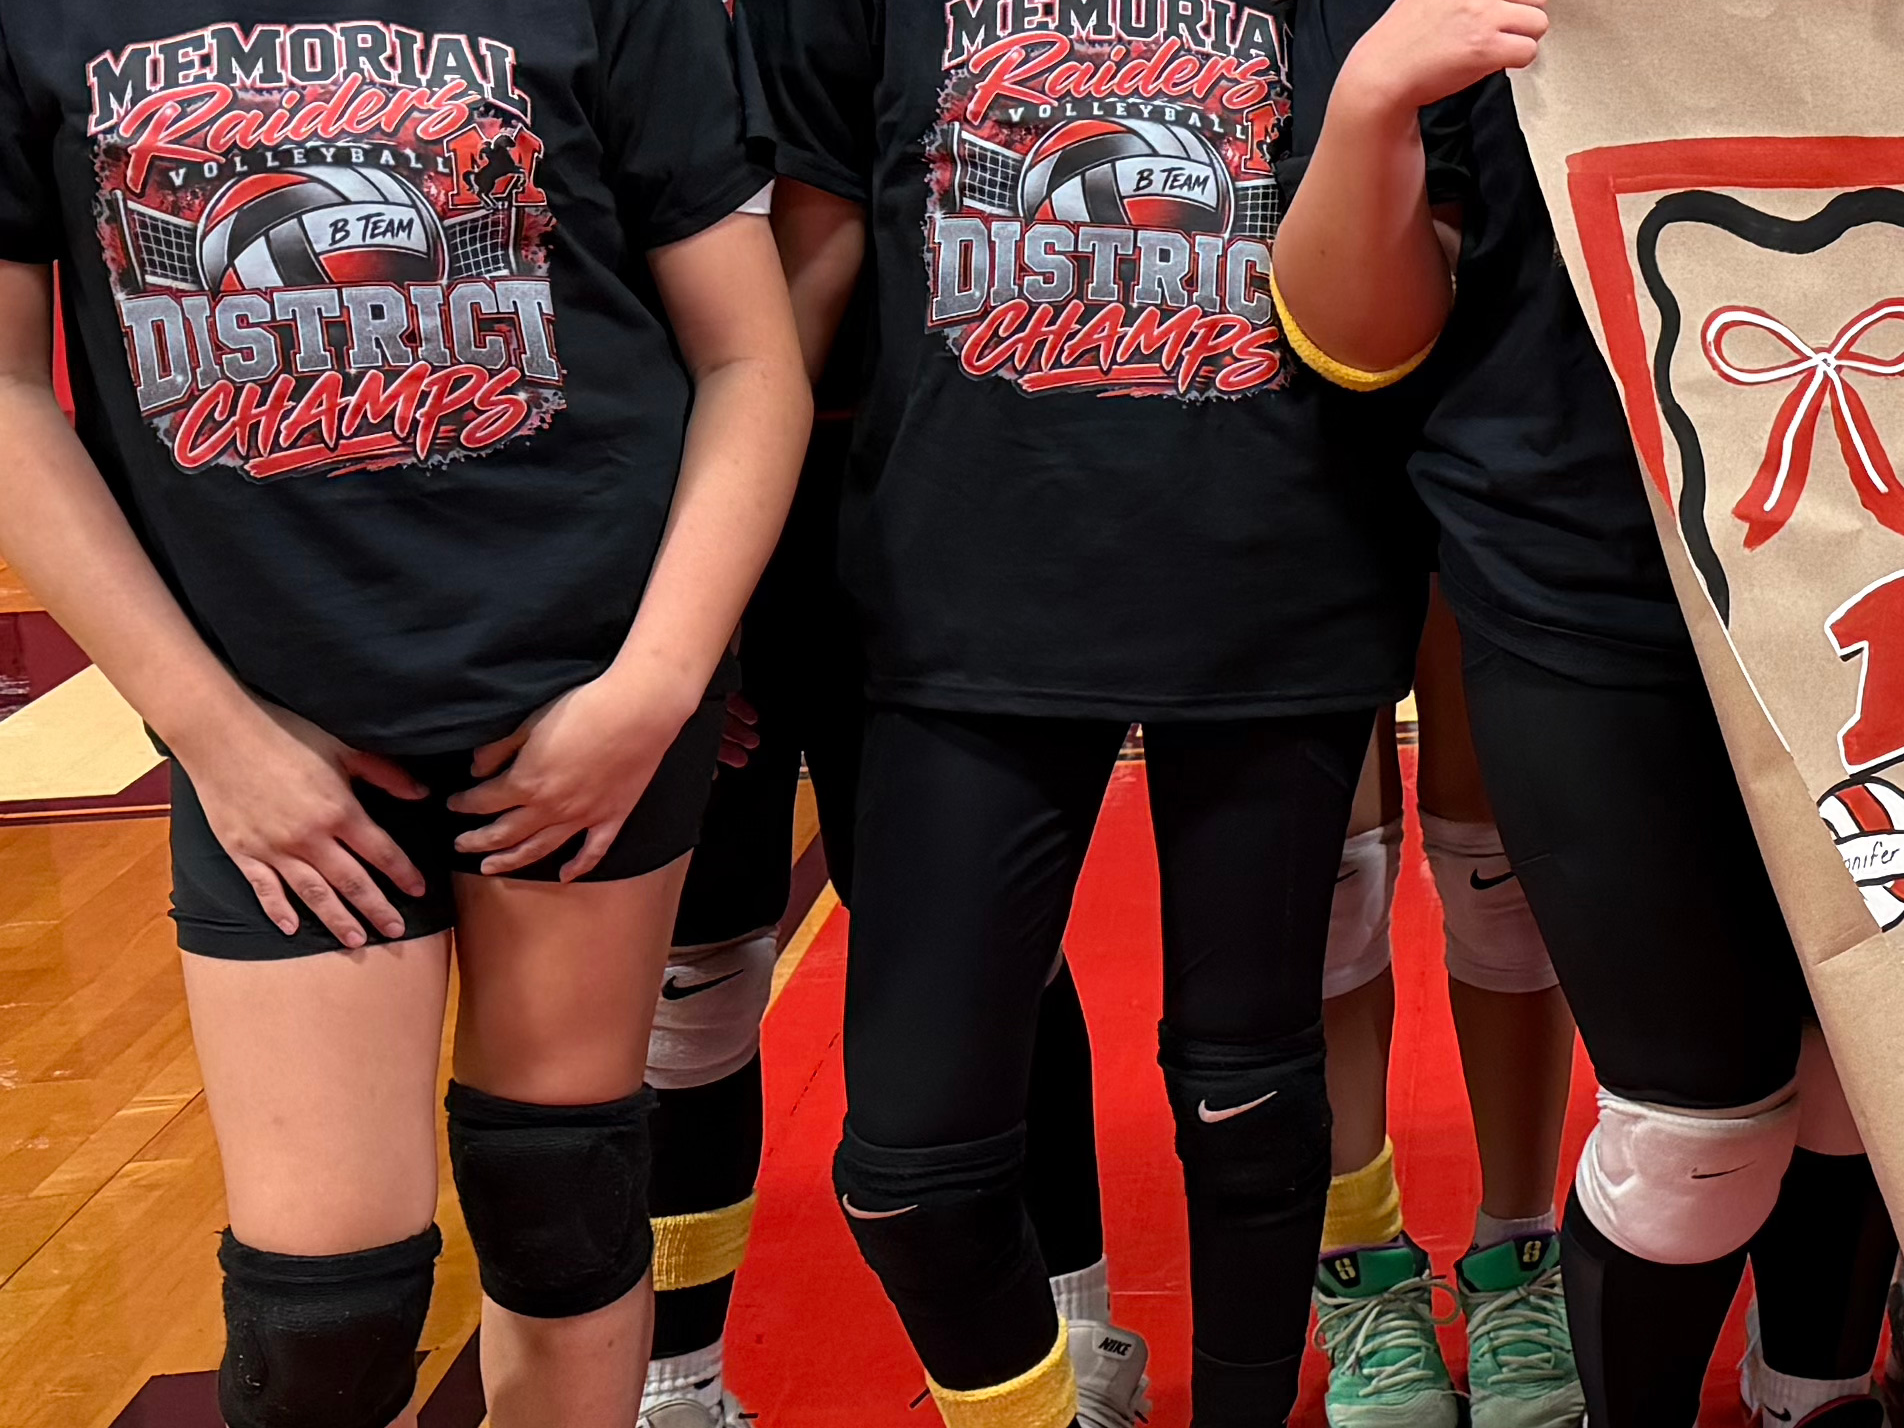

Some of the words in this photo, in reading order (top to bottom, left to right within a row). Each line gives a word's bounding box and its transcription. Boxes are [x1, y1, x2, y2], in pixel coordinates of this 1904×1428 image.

[87, 20, 531, 137] MEMORIAL
[966, 30, 1270, 127] Raiders
[1009, 101, 1247, 139] VOLLEYBALL
[122, 73, 482, 198] Raiders
[168, 145, 450, 187] VOLLEYBALL
[1134, 167, 1153, 193] B
[1159, 167, 1210, 195] TEAM
[328, 216, 351, 246] B
[355, 213, 415, 241] TEAM
[930, 215, 1275, 327] DISTRIC
[119, 277, 564, 415] DISTRICT
[962, 299, 1281, 398] CHAMPS
[171, 361, 529, 469] CHAMPS
[1098, 1336, 1132, 1356] NIKE
